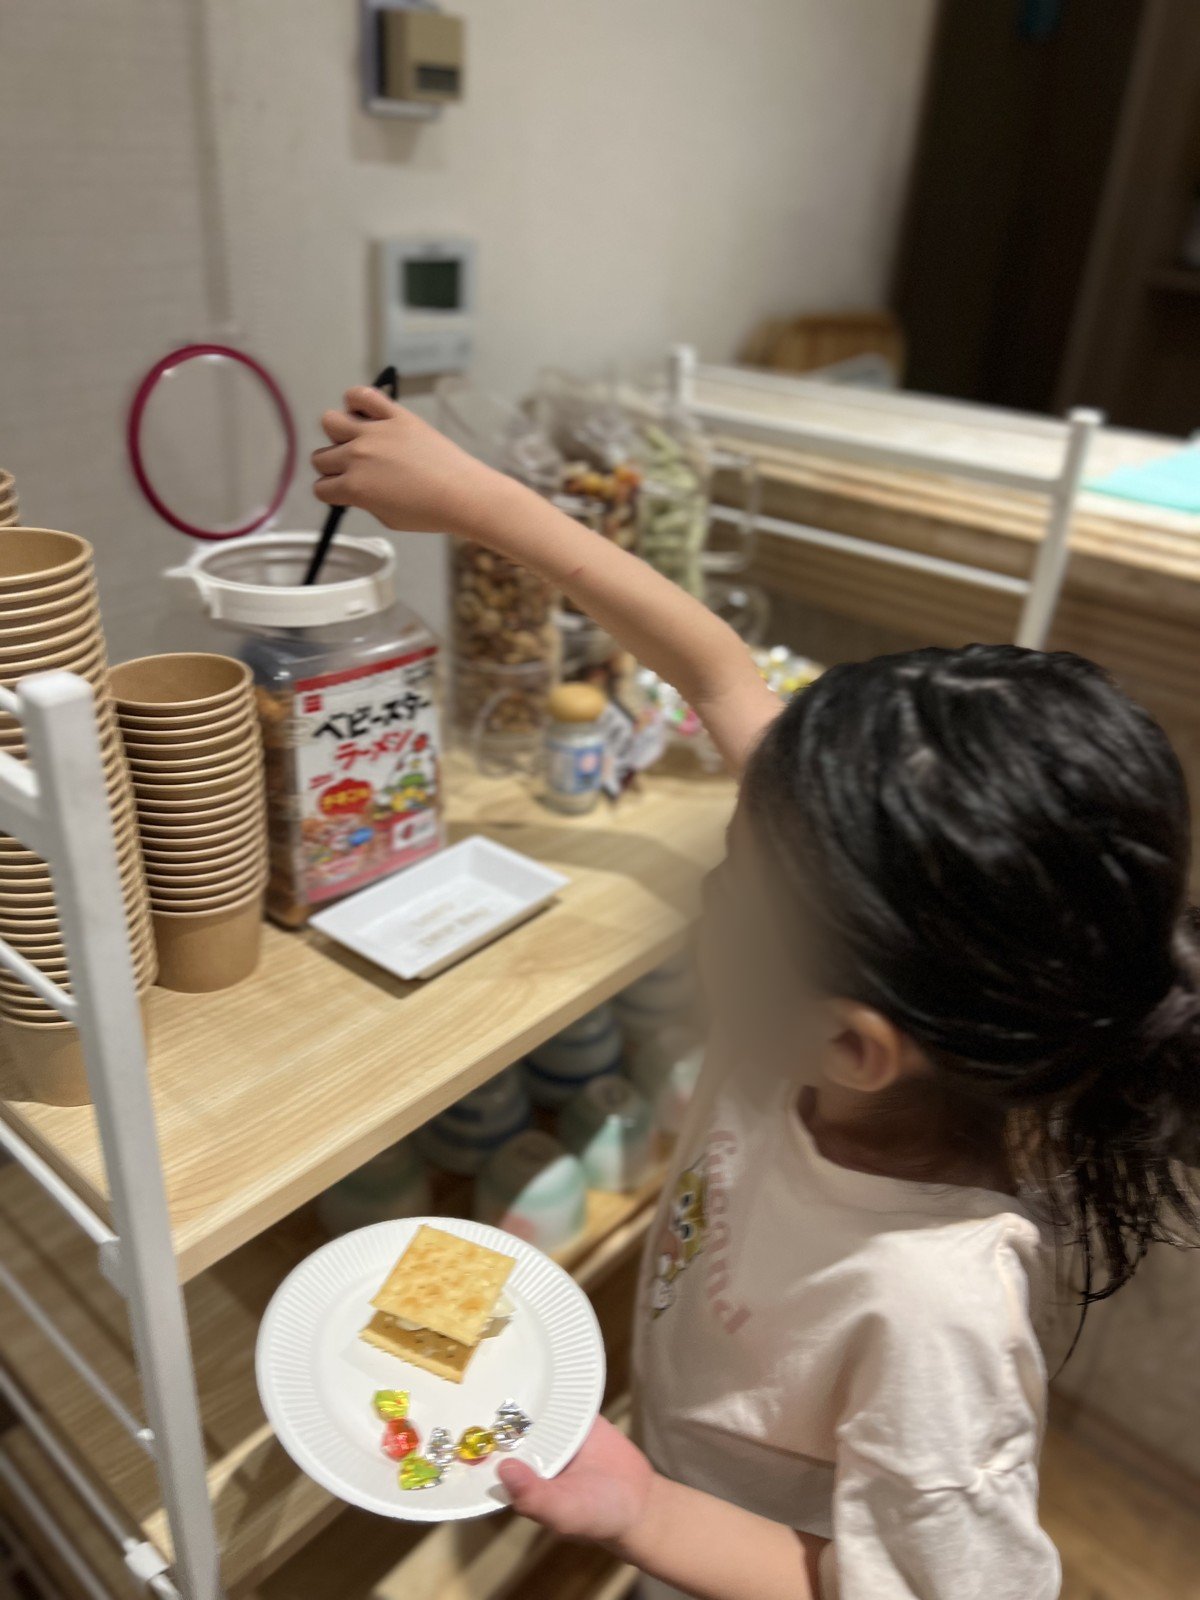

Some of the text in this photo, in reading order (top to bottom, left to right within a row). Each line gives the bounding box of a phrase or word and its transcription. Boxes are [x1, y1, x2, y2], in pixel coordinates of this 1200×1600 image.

[313, 692, 431, 739] ベビースター
[334, 729, 413, 770] ラーメン
